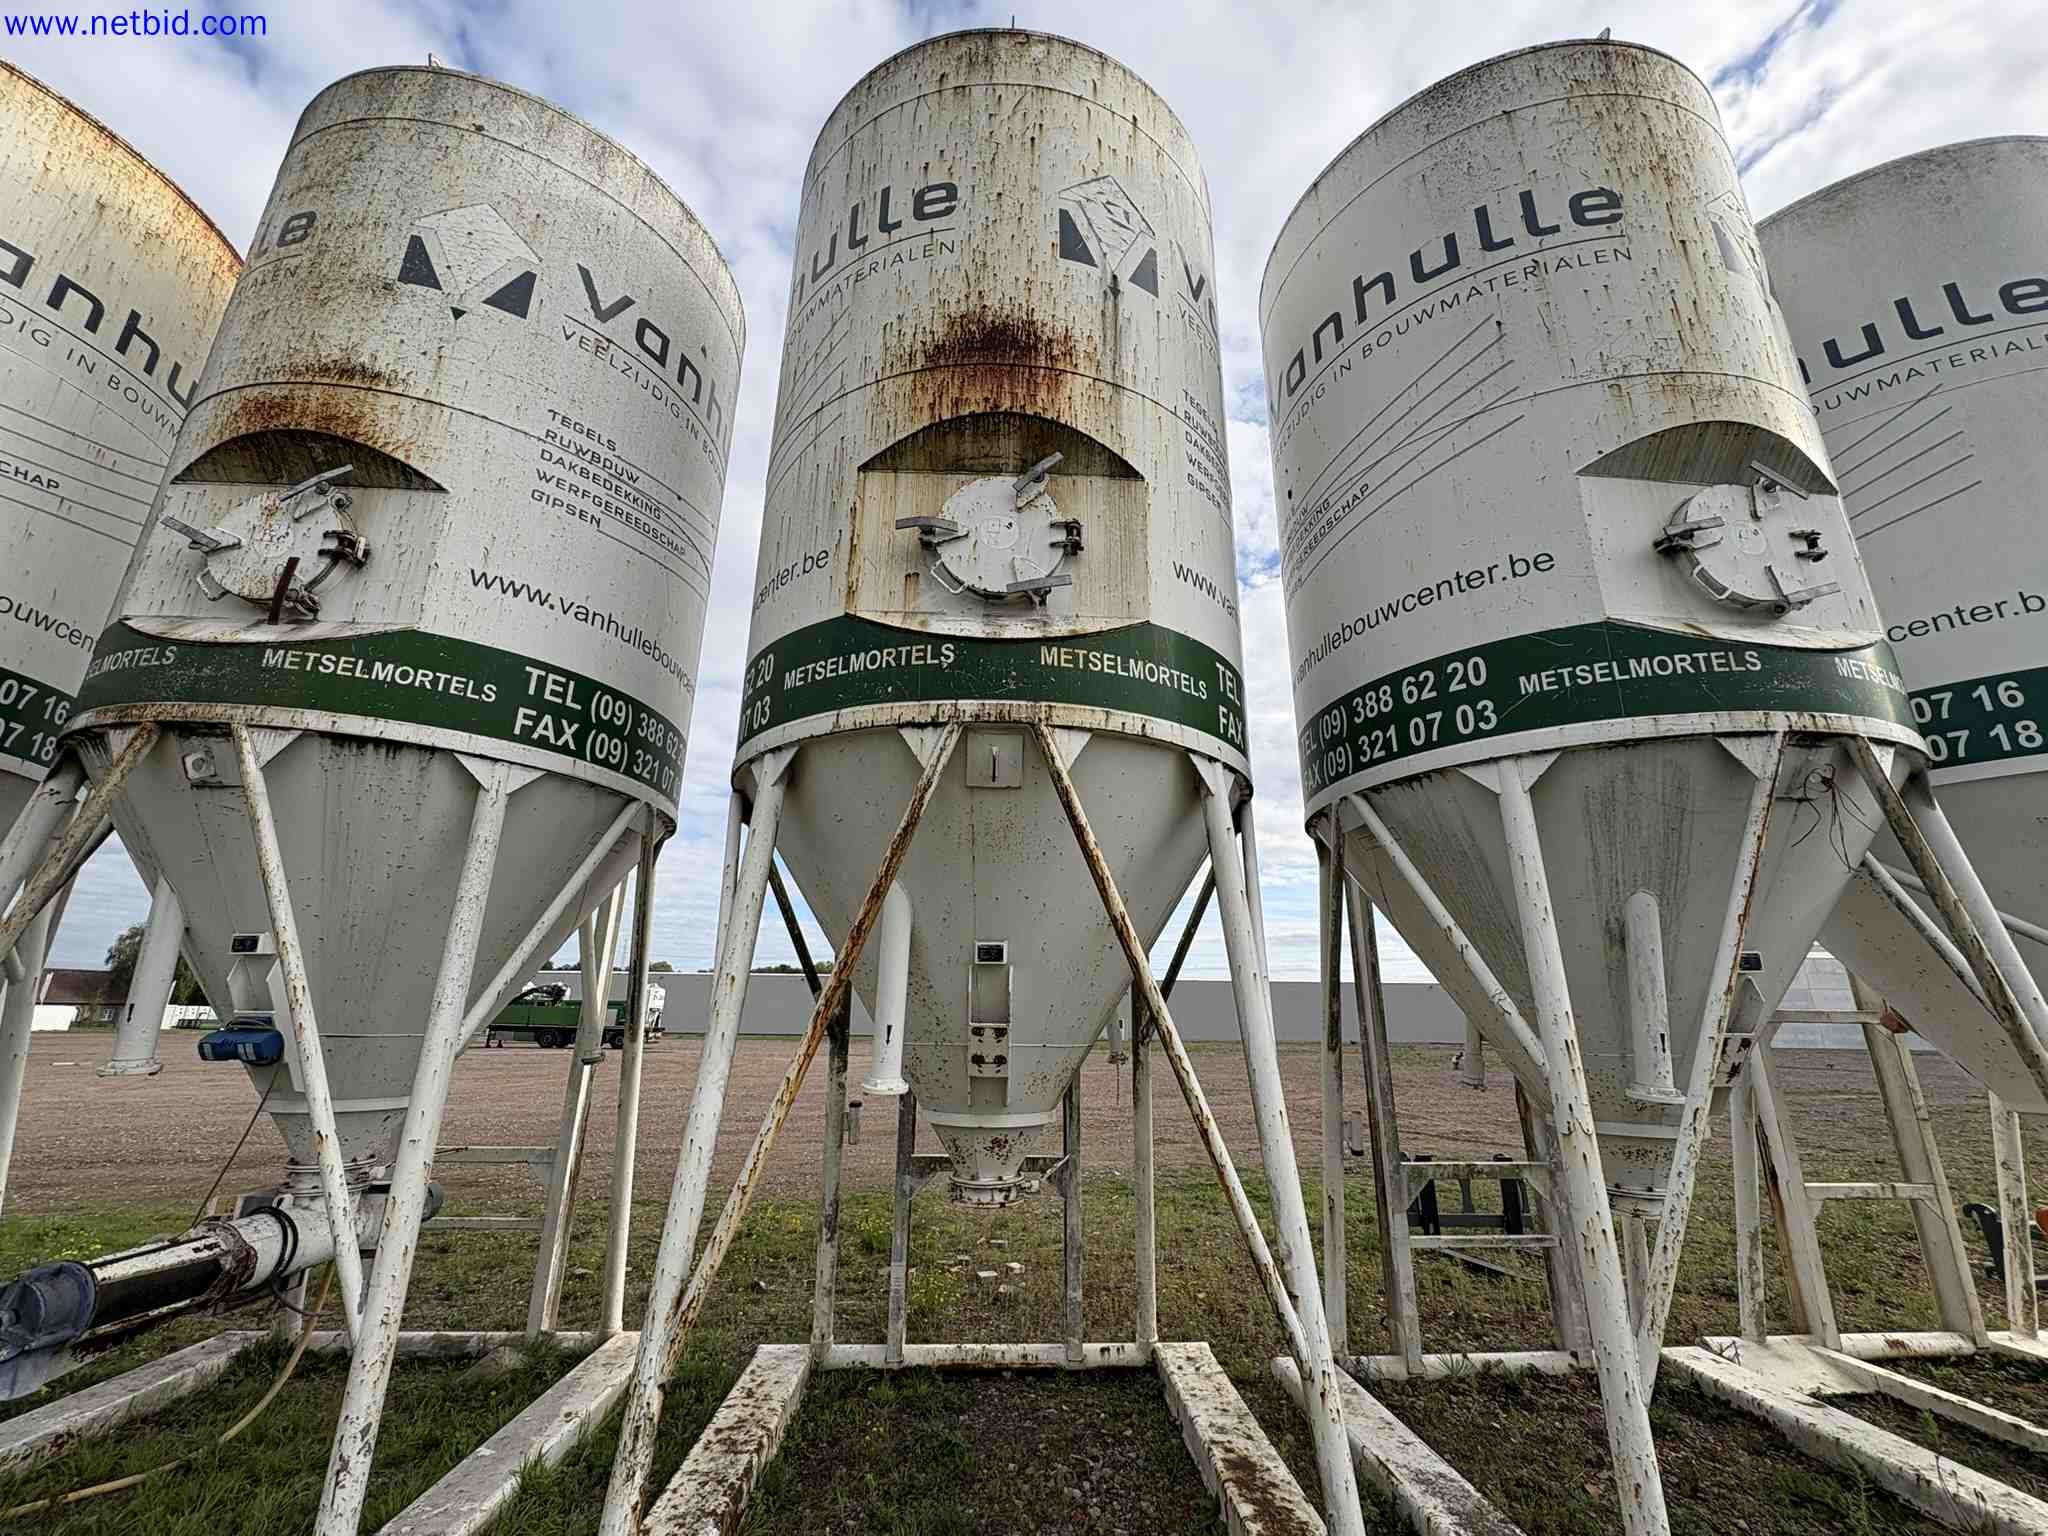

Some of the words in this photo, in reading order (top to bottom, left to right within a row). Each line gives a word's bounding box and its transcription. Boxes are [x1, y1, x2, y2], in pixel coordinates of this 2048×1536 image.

[1334, 358, 1352, 382] IN
[1362, 246, 1633, 359] BOUWMATERIALEN
[66, 348, 97, 374] IN
[561, 325, 681, 418] VEELZIJDIG
[685, 417, 699, 441] IN
[1812, 333, 2048, 418] UWMATERIAL
[547, 409, 618, 452] TEGELS
[545, 429, 640, 484] RUWBOUW
[531, 488, 602, 529] GIPSEN
[540, 449, 662, 520] DAKBEDEKKING
[535, 468, 687, 556] WERFGEREEDSCHAP
[262, 648, 497, 702] METSELMORTELS
[756, 652, 775, 690] 20
[784, 643, 955, 691] METSELMORTELS
[1040, 644, 1208, 700] METSELMORTELS
[1216, 660, 1241, 707] TEL
[1518, 650, 1762, 695] METSELMORTELS
[0, 679, 38, 710] 07
[43, 695, 71, 726] 16
[525, 665, 582, 711] TEL
[591, 690, 633, 736] (09)
[637, 713, 665, 748] 388
[753, 695, 771, 731] 03
[1319, 705, 1347, 749] (09)
[1353, 685, 1394, 724] 388
[1401, 670, 1438, 704] 62
[1446, 656, 1487, 693] 20
[1910, 691, 1953, 724] 07
[1971, 680, 2025, 712] 16
[31, 732, 57, 762] 18
[513, 706, 581, 751] FAX
[586, 729, 628, 773] (09)
[633, 750, 660, 783] 321
[1219, 704, 1245, 750] FAX
[1324, 742, 1353, 785] (09)
[1358, 724, 1398, 764] 321
[1410, 711, 1443, 748] 07
[1456, 699, 1498, 736] 03
[1925, 729, 1970, 763] 07
[1989, 719, 2044, 752] 18
